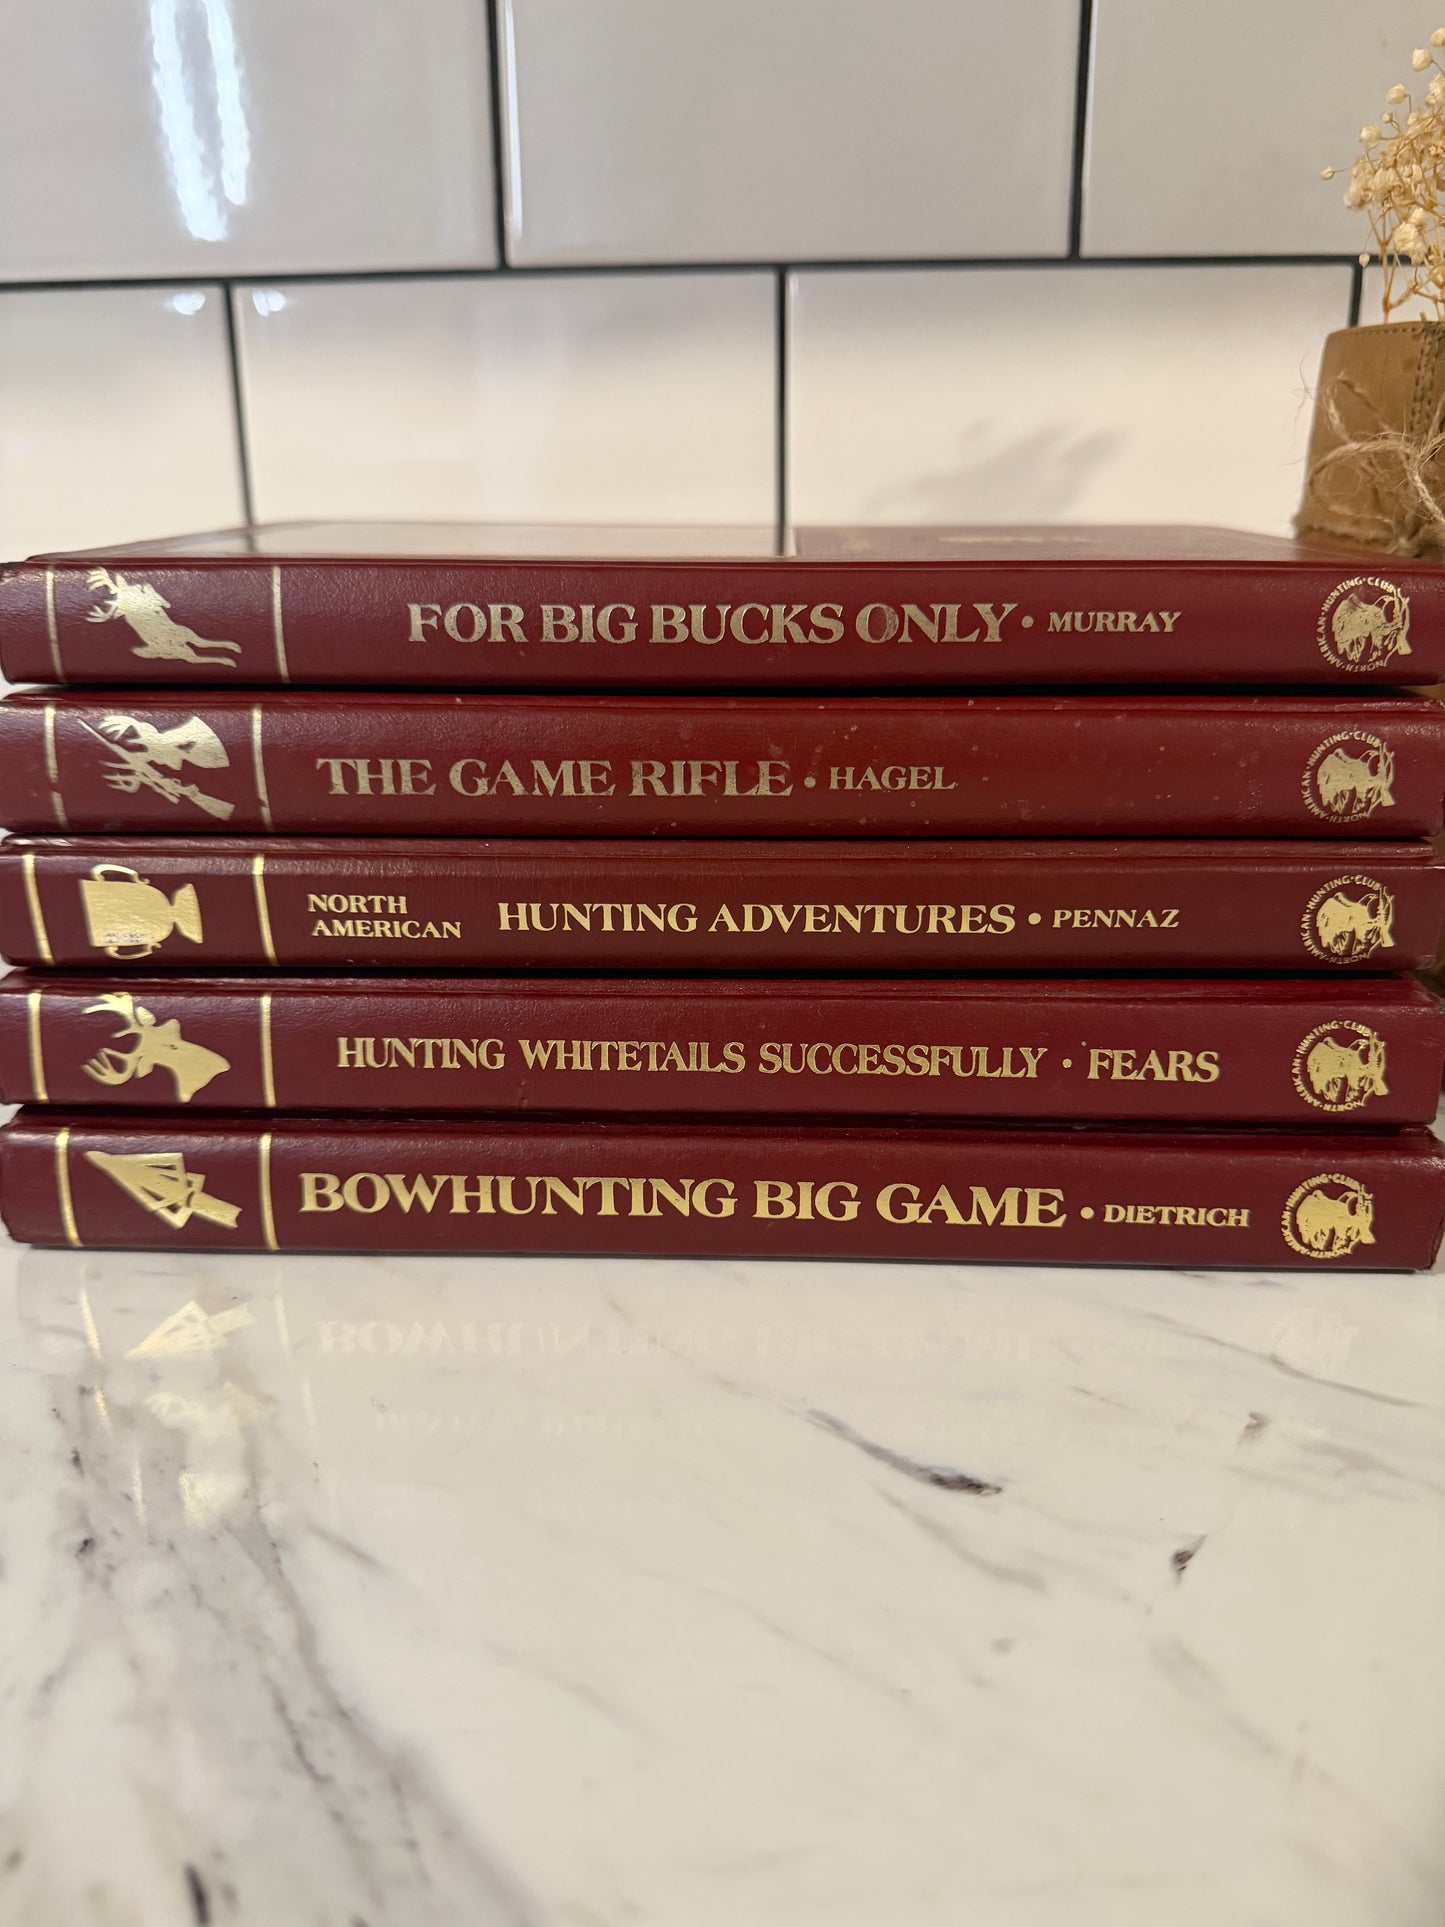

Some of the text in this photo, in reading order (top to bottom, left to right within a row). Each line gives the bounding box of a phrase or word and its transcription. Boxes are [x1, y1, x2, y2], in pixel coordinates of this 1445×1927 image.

[1321, 576, 1362, 612] HUNTING
[406, 602, 1182, 645] FOR BIG BUCKS ONLY MURRAY
[1307, 731, 1350, 766] HUNTING
[316, 757, 956, 797] THE GAME RIFLE HAGEL
[307, 893, 408, 916] NORTH
[1306, 875, 1351, 910] HUNTING
[1354, 874, 1382, 891] CLUB
[312, 919, 462, 940] AMERICAN
[497, 902, 1180, 935] HUNTING ADVENTURES PENNAZ
[336, 1037, 1220, 1083] HUNTING WHITETAILS SUCCESSFULLY FEARS
[299, 1172, 1250, 1229] BOWHUNTING BIG GAME DIETRICH
